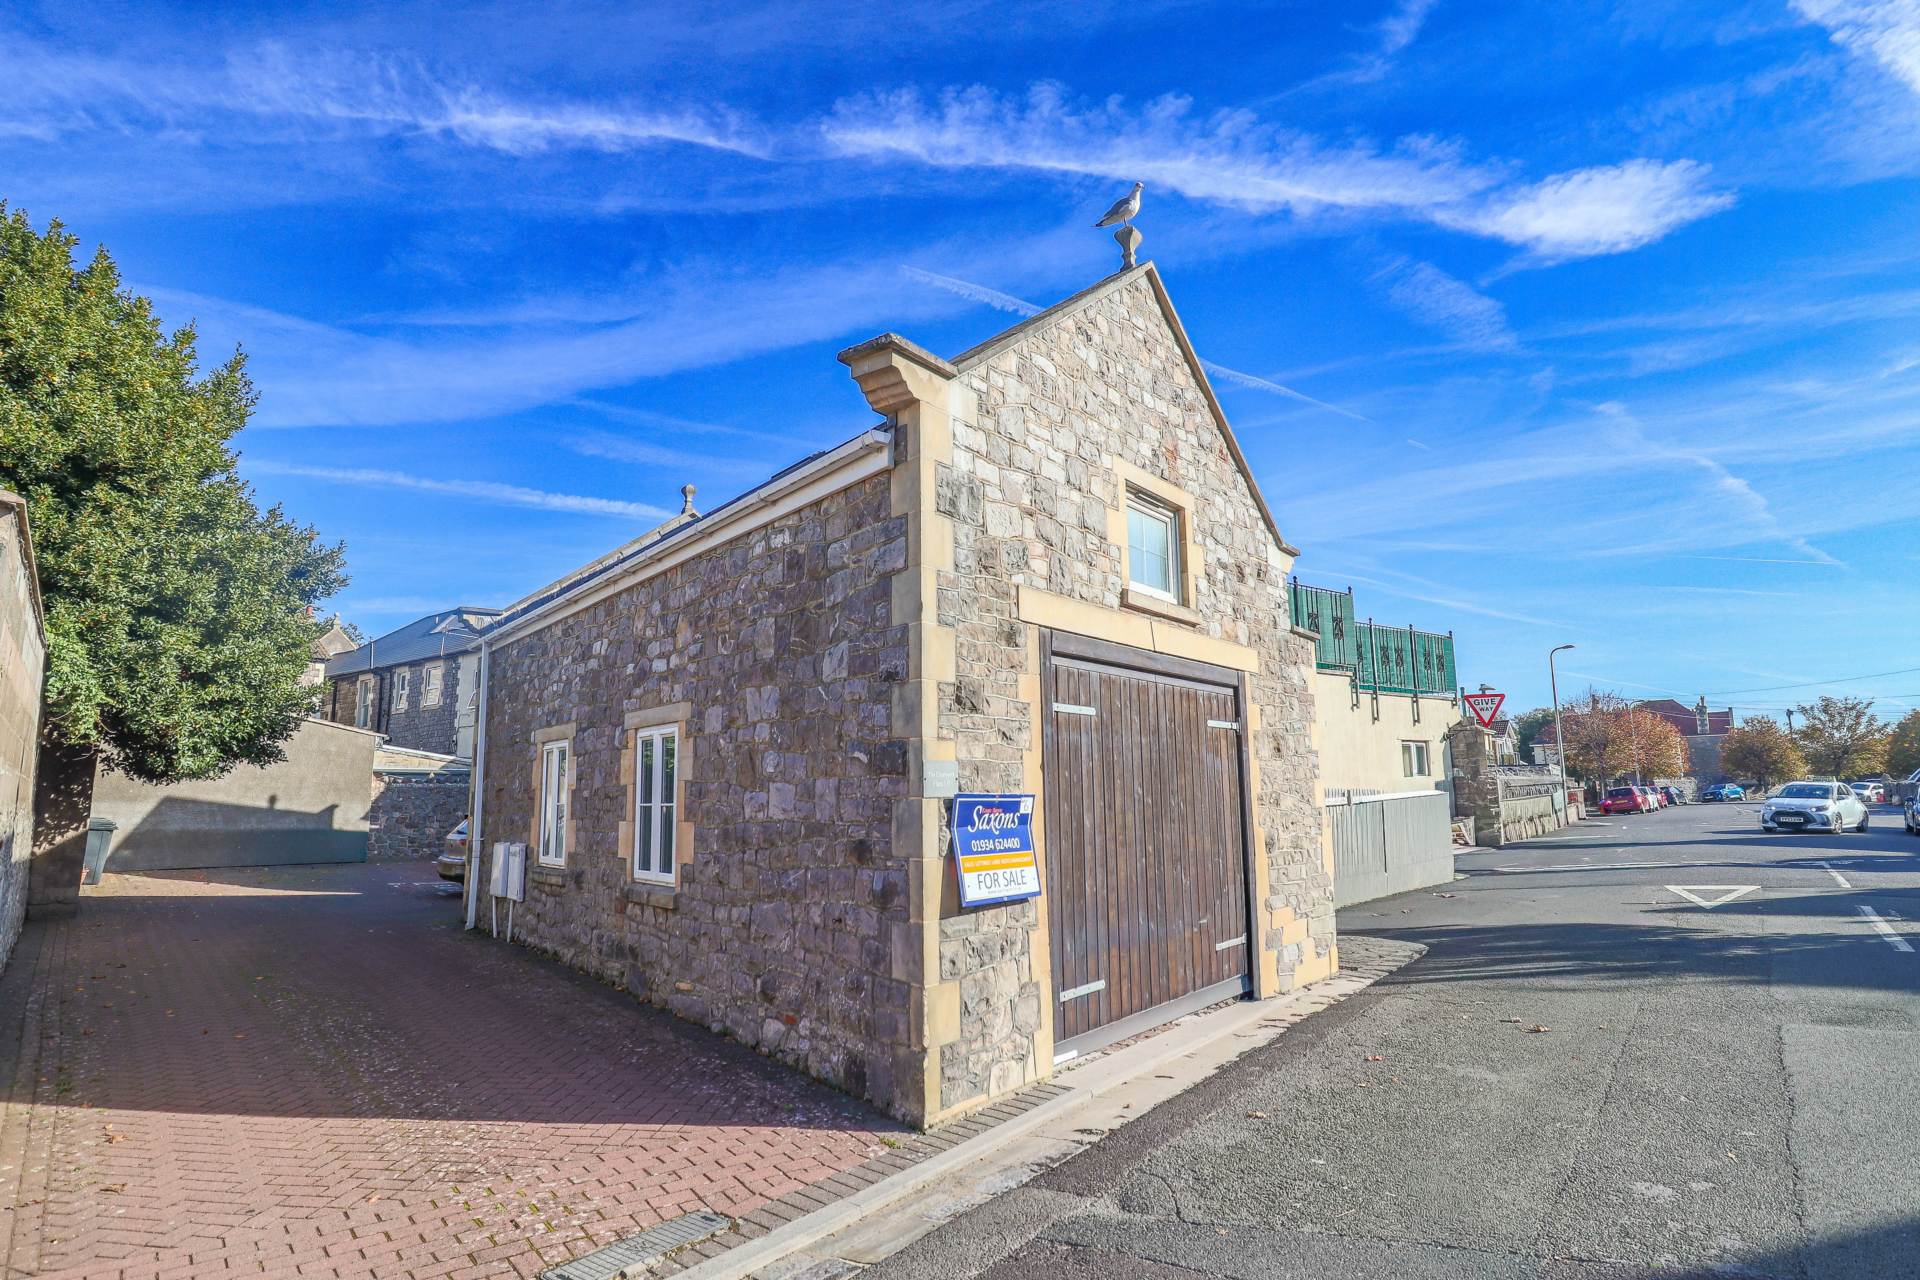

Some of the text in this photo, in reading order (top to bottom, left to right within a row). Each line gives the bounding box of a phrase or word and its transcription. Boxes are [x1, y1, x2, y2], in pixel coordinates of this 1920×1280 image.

[967, 805, 1020, 835] Saxons
[971, 837, 1020, 851] 01934 624400
[977, 869, 1027, 890] FOR SALE
